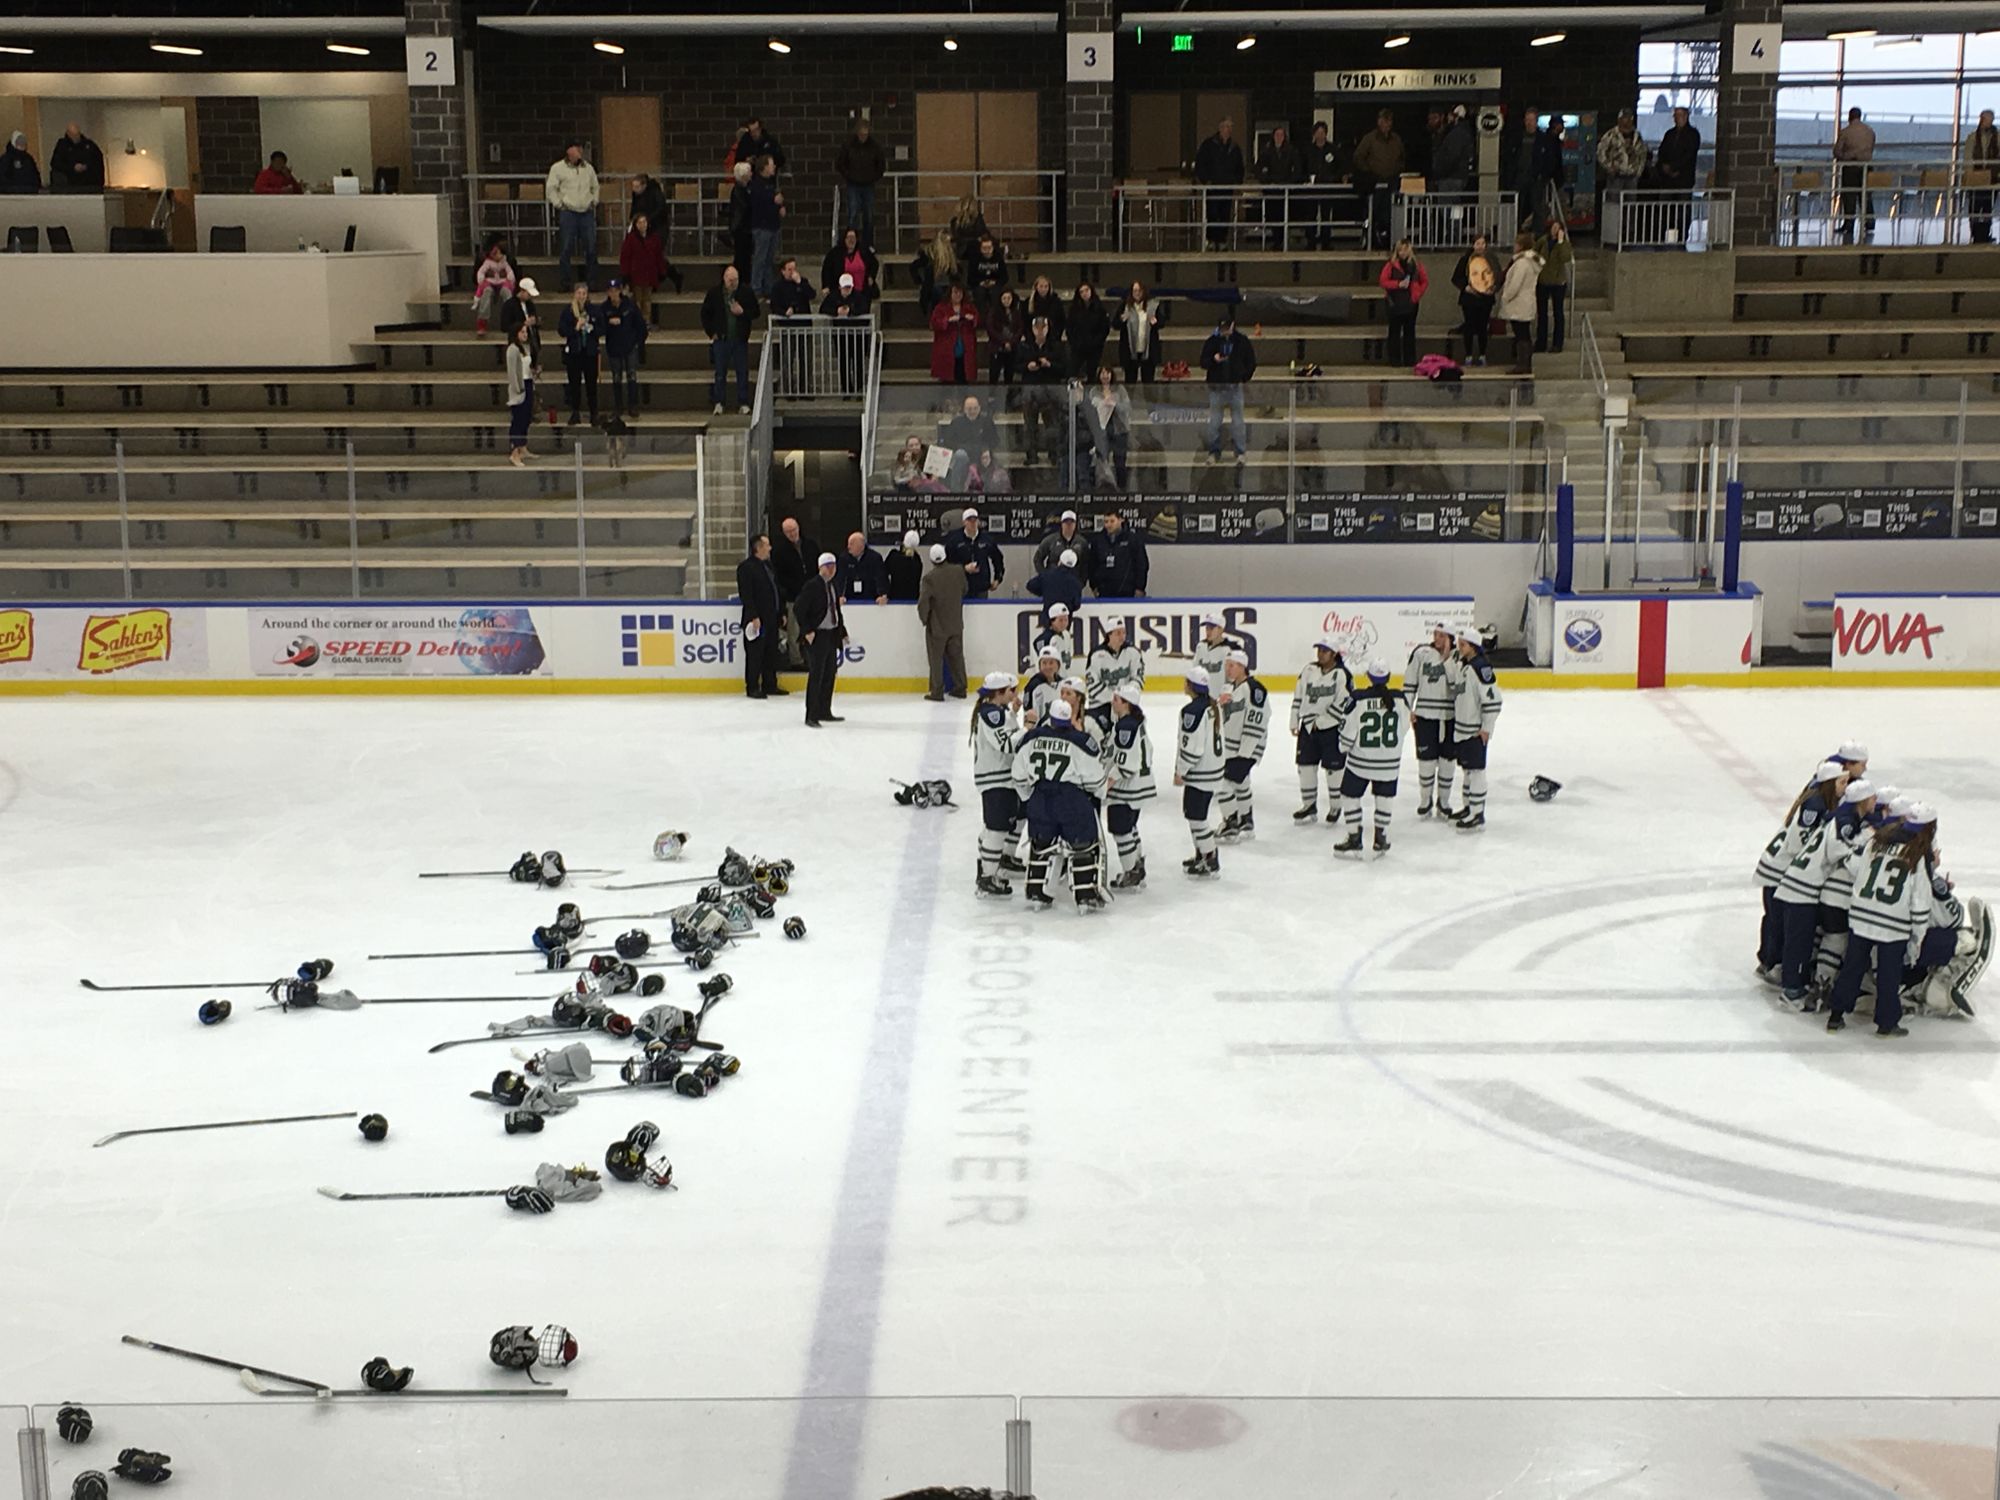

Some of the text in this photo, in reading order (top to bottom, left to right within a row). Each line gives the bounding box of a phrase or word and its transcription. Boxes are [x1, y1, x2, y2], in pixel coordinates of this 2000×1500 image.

[1751, 38, 1764, 59] 4
[425, 51, 437, 71] 2
[1084, 47, 1096, 67] 3
[1379, 75, 1396, 87] AT
[1434, 73, 1477, 86] RINKS
[784, 450, 804, 499] 1
[1334, 507, 1357, 517] THIS
[1440, 507, 1462, 516] THIS
[1780, 504, 1802, 514] THIS
[1887, 503, 1910, 512] THIS
[907, 509, 929, 519] THIS
[1011, 509, 1034, 519] THIS
[1221, 508, 1244, 518] THIS
[1886, 513, 1896, 522] IS
[1898, 513, 1918, 522] THE
[907, 519, 937, 528] IS THE
[1011, 519, 1041, 529] IS THE
[1128, 518, 1147, 528] THE
[1221, 518, 1251, 528] IS THE
[1333, 518, 1343, 527] IS
[1346, 517, 1364, 527] THE
[1439, 517, 1470, 527] IS THE
[1779, 514, 1810, 524] IS THE
[1011, 529, 1030, 538] CAP
[1221, 528, 1241, 537] CAP
[1333, 527, 1353, 537] CAP
[1439, 527, 1459, 536] CAP
[1778, 525, 1799, 534] CAP
[1886, 524, 1906, 533] CAP
[262, 618, 308, 629] Around
[312, 618, 330, 629] the
[333, 619, 372, 629] corner
[375, 620, 389, 629] or
[392, 618, 438, 629] around
[441, 618, 457, 629] the
[682, 618, 741, 636] Uncle
[1323, 611, 1363, 633] Chef's
[89, 619, 163, 659] Sahlen's
[322, 641, 412, 656] SPEED
[682, 639, 737, 664] self
[1486, 687, 1494, 700] 4
[1247, 710, 1263, 724] 20
[1360, 711, 1399, 748] 28
[1029, 752, 1071, 781] 37
[1860, 855, 1911, 905] 13
